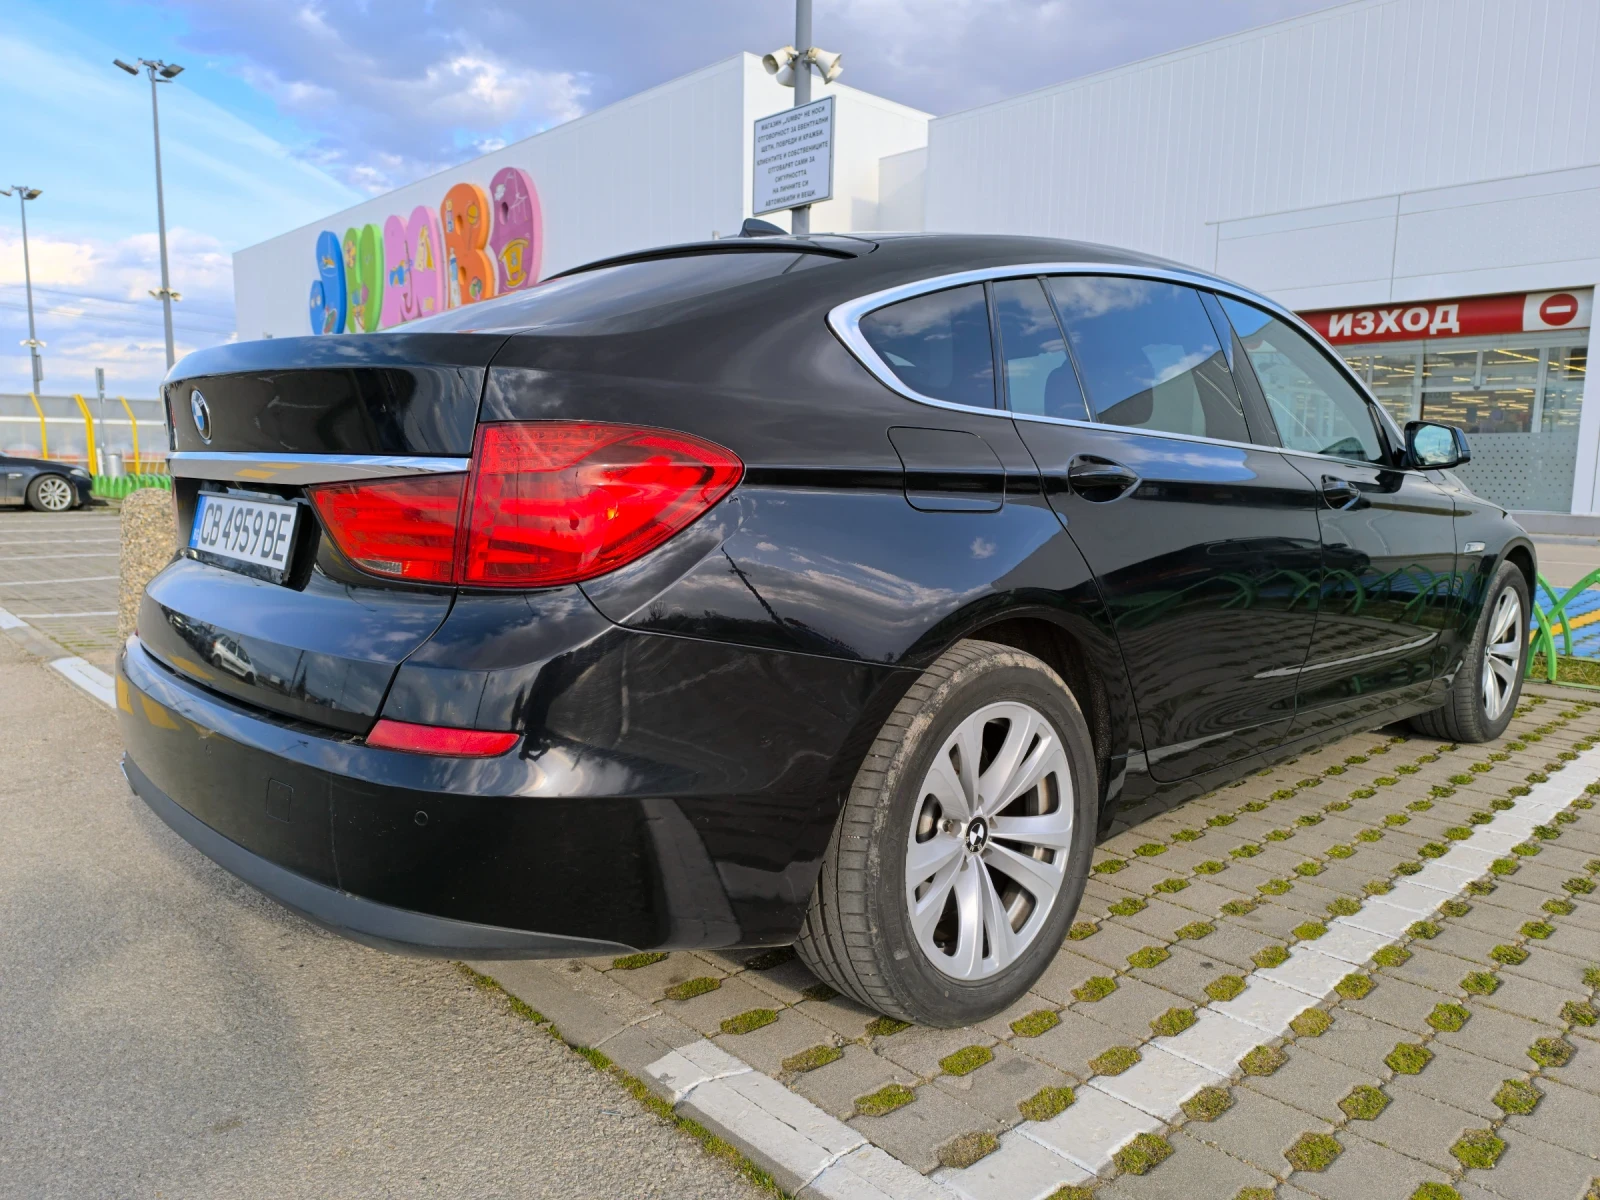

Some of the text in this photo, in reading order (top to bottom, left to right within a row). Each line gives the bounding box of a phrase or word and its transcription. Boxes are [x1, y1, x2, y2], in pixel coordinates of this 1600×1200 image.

[758, 128, 789, 142] ОТГОВОРНОСТ
[798, 116, 828, 131] ЕВЕНТУАЛНИ
[761, 120, 782, 130] МАГАЗИН
[812, 106, 825, 115] НОСИ
[757, 154, 782, 166] КЛИЕНТИТЕ
[788, 141, 828, 158] СОБСТВЕНИЦИТЕ
[776, 138, 797, 148] ПОВРЕДИ
[768, 162, 793, 174] ОТГОВАРЯТ
[775, 169, 807, 182] СИГУРНОСТТА
[780, 182, 801, 192] ЛИЧНИТЕ
[765, 194, 795, 207] АВТОМОБИЛИ
[310, 167, 543, 335] JUMBO
[1328, 304, 1459, 337] ИЗХОД
[222, 506, 264, 556] 4959
